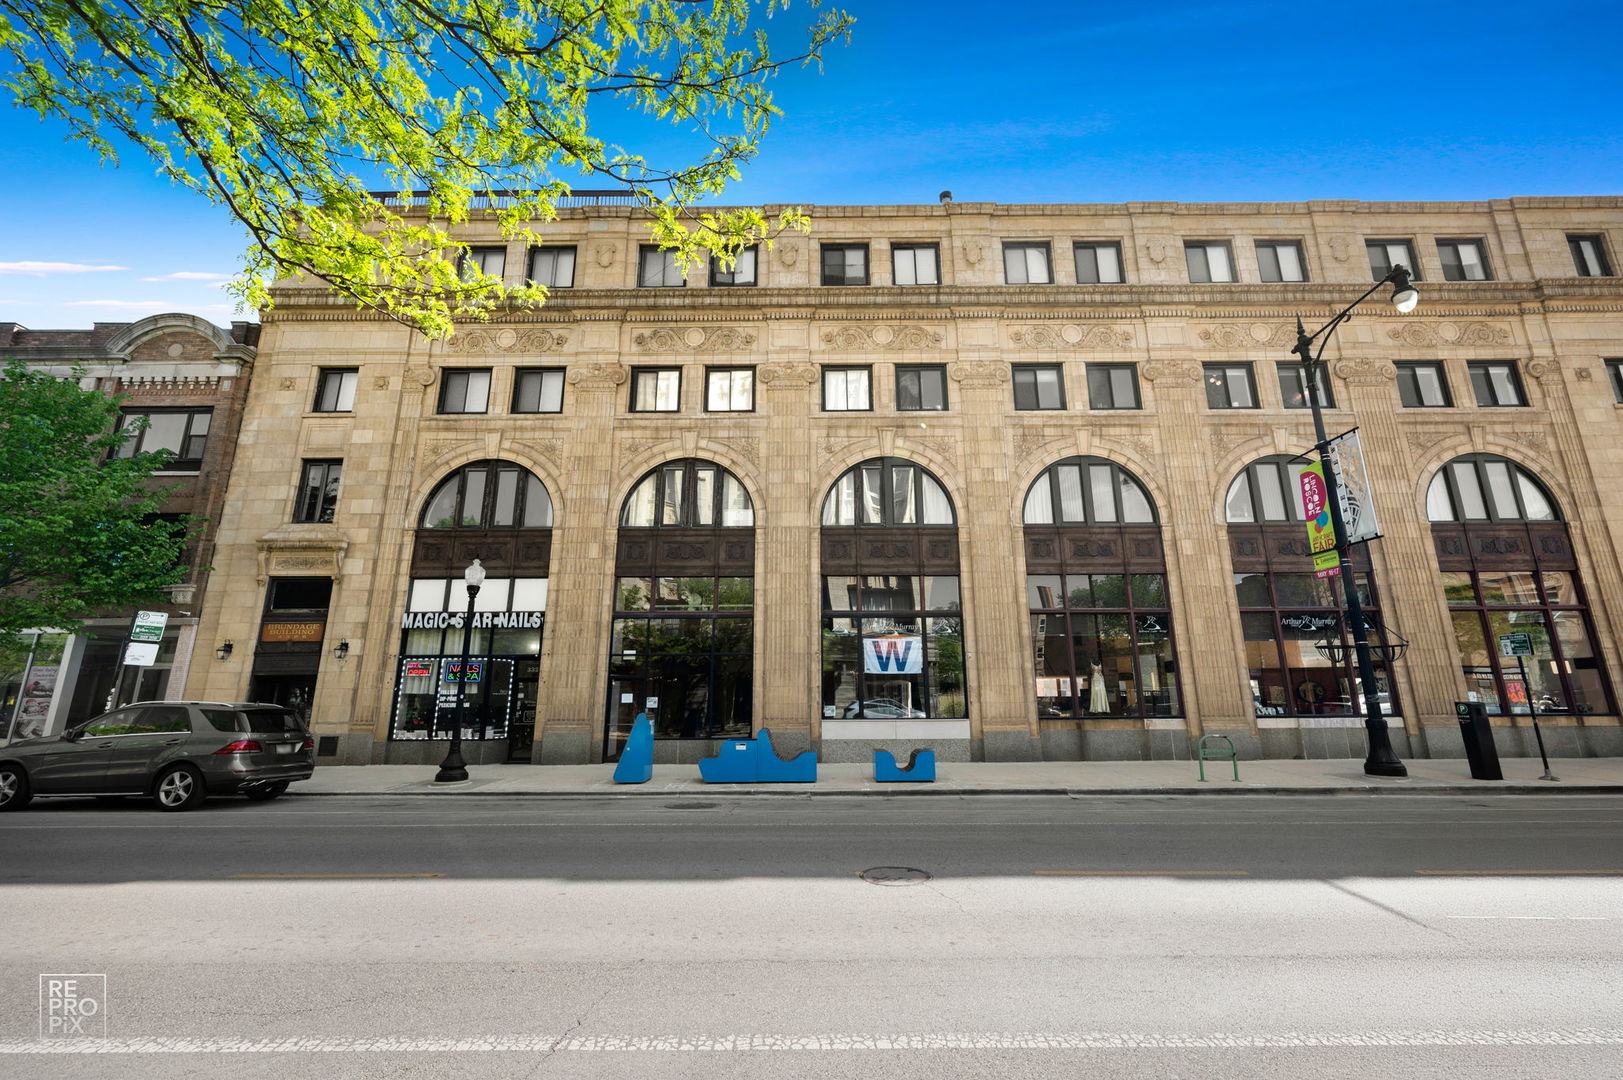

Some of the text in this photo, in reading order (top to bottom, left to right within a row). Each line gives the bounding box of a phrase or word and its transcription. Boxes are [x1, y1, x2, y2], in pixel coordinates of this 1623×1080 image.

[1303, 477, 1316, 516] ROSCOE
[1309, 474, 1321, 514] LINCOLN
[1313, 538, 1335, 552] FAIR
[267, 623, 320, 631] BRUNDAGE
[401, 612, 541, 629] MAGIC SAR NAILS
[895, 623, 918, 632] Murray
[1281, 617, 1336, 627] Arthur Murray
[871, 640, 913, 672] W
[449, 664, 480, 673] NALS
